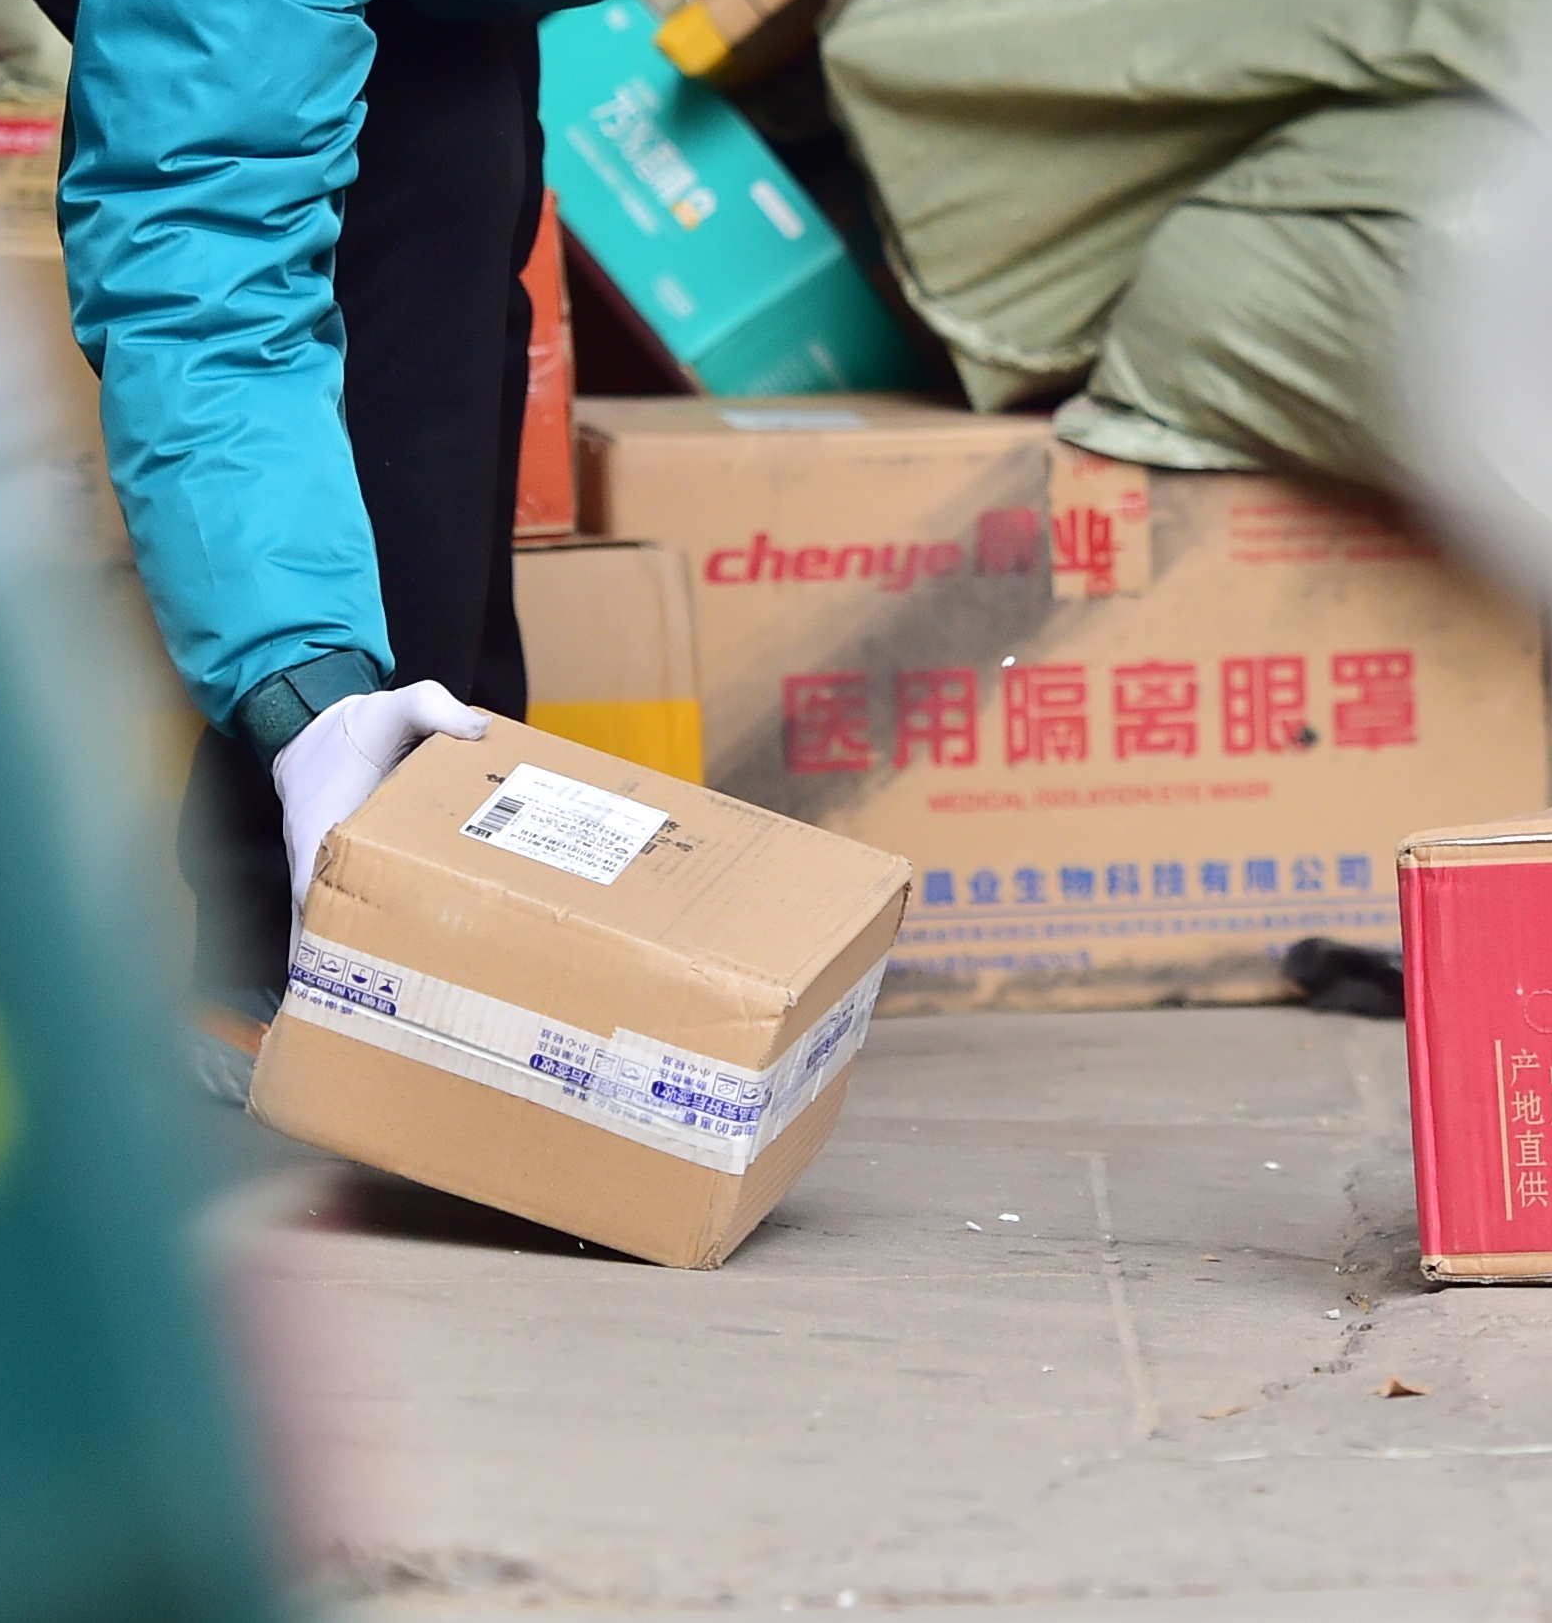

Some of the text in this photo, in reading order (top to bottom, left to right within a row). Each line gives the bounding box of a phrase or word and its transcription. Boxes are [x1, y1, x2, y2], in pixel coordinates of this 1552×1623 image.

[783, 651, 1418, 774] 医用隔离眼罩
[289, 980, 353, 1015] 感谢您的
[537, 1040, 586, 1066] 防潮防压
[540, 1028, 589, 1054] 小心轻放
[662, 1055, 711, 1079] 小心轻放
[1510, 1048, 1549, 1210] 产地直供
